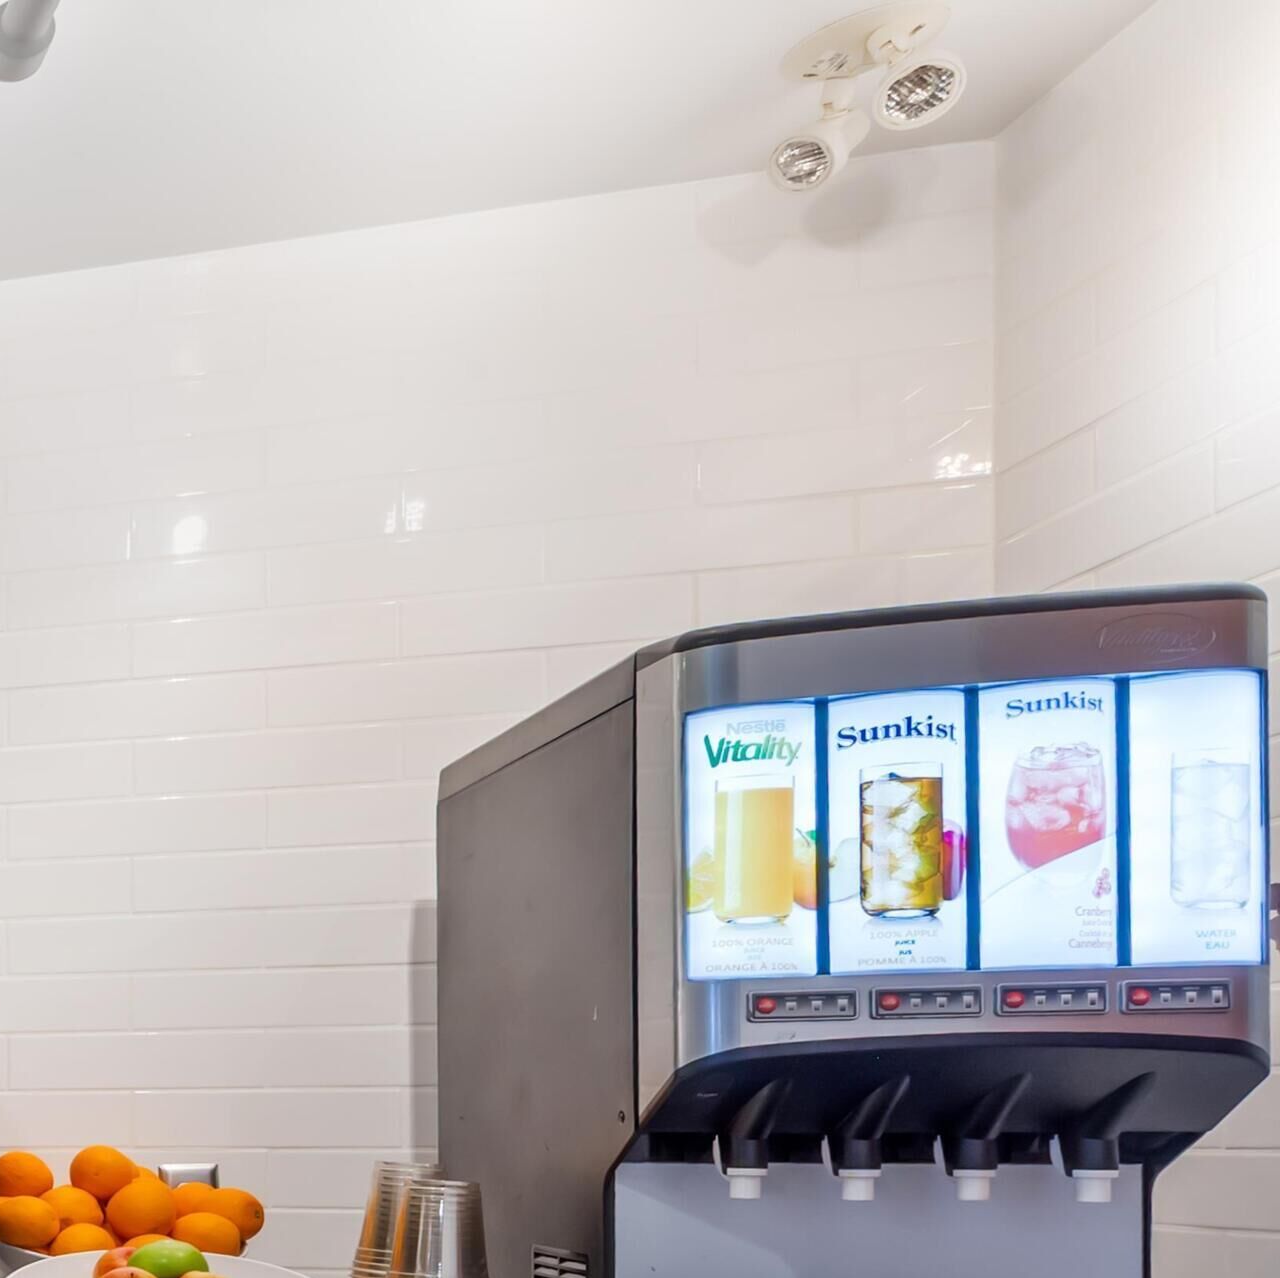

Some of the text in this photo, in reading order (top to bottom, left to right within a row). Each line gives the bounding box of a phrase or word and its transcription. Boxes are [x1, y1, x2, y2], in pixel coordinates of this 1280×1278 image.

[1006, 690, 1104, 719] Sunkist
[836, 715, 958, 751] Sunkist
[704, 733, 802, 768] Vitality
[1194, 929, 1237, 938] WATER
[1205, 941, 1231, 950] EAU
